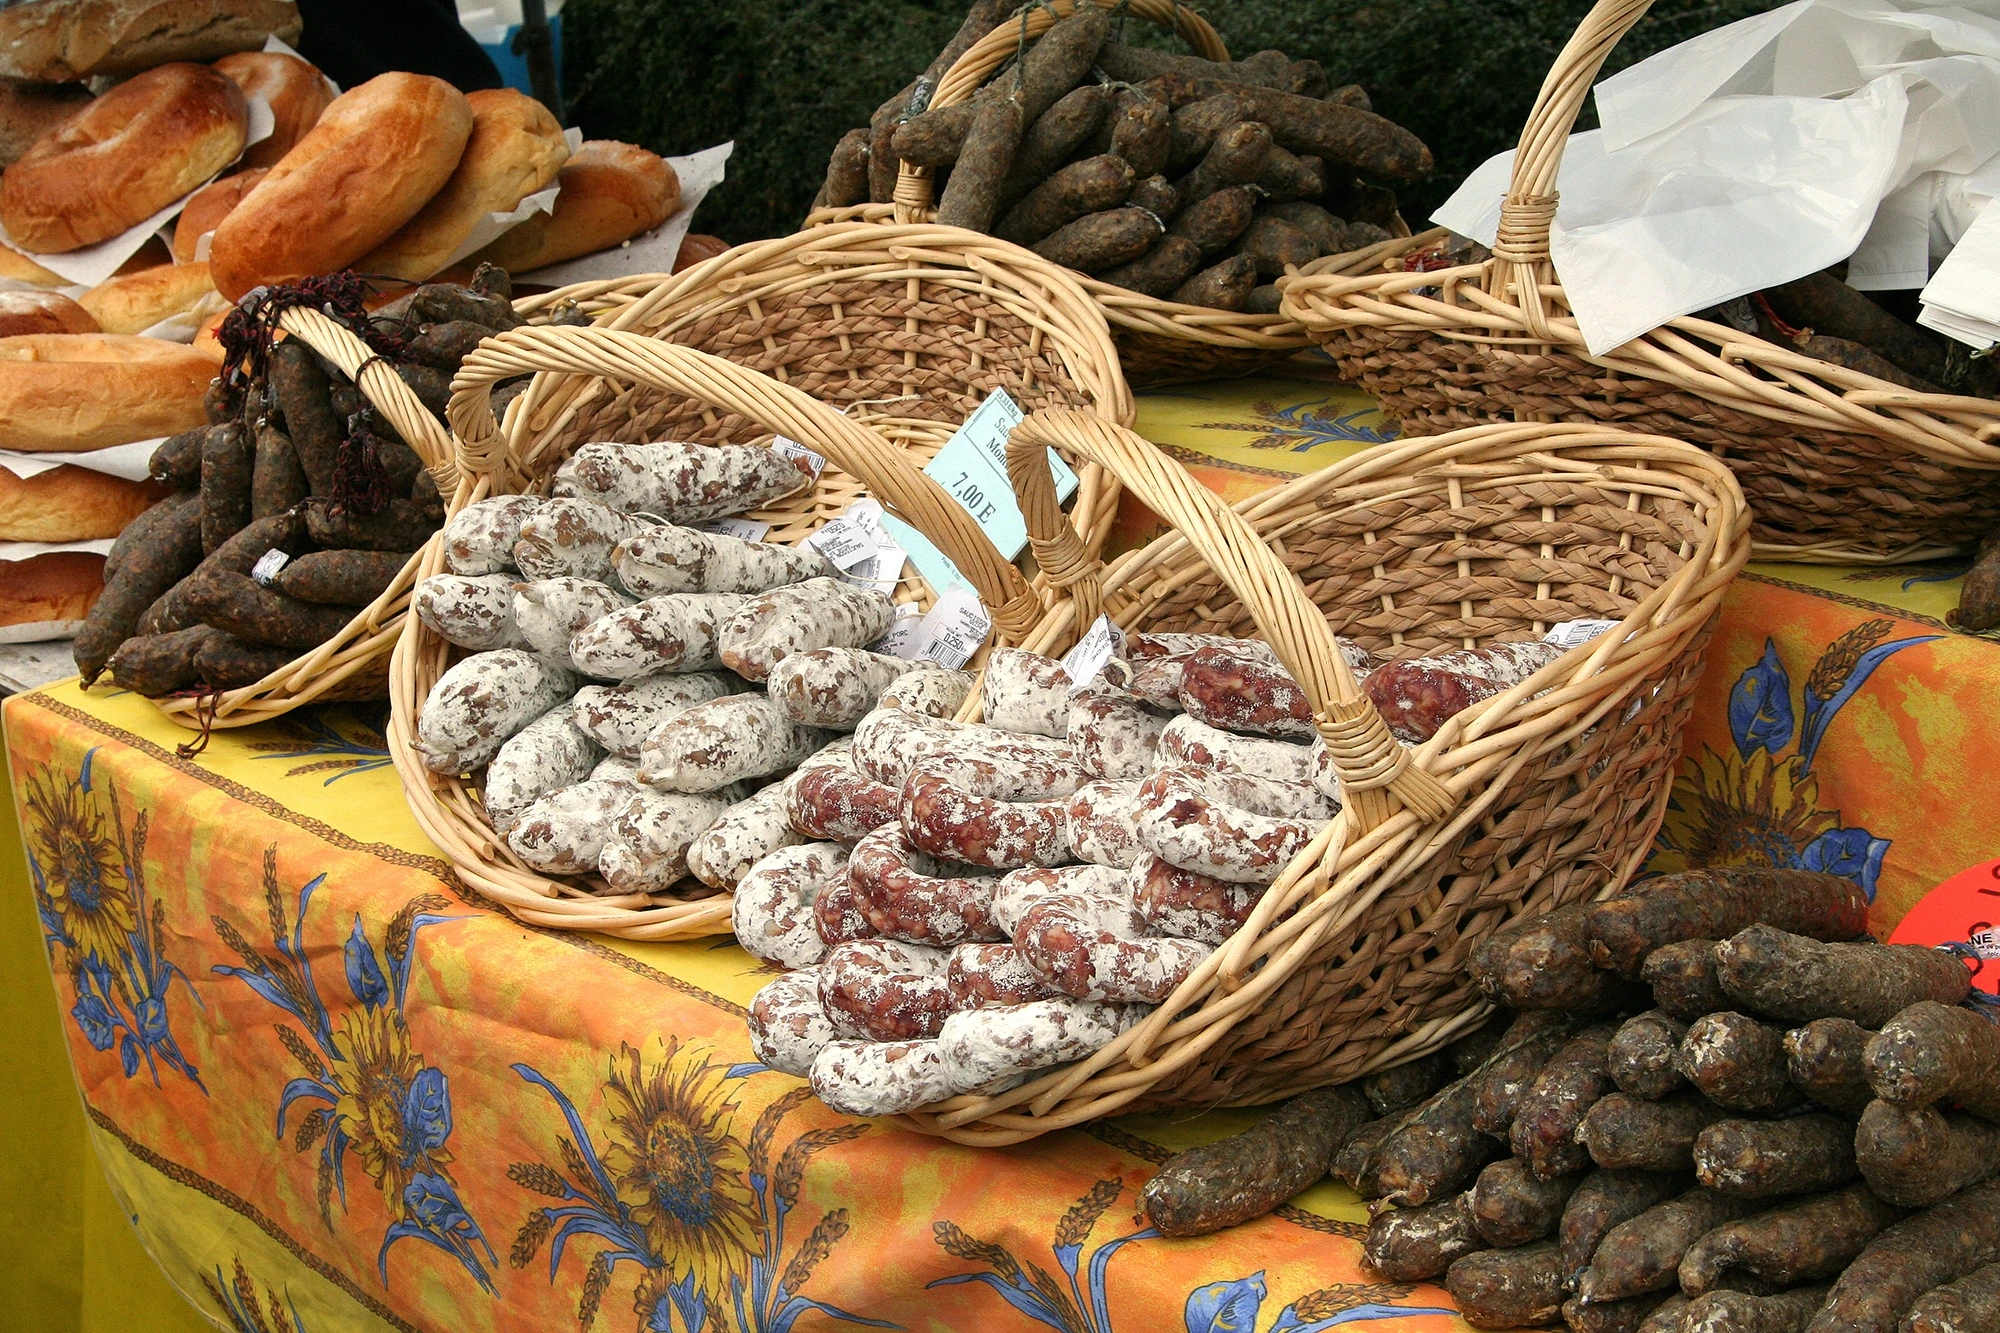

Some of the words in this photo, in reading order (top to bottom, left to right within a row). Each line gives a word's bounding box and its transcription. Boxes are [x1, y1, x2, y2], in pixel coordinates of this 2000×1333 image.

[994, 416, 1010, 439] Sau
[952, 471, 984, 509] 7,00
[976, 501, 997, 524] E
[1969, 933, 1993, 946] NE
